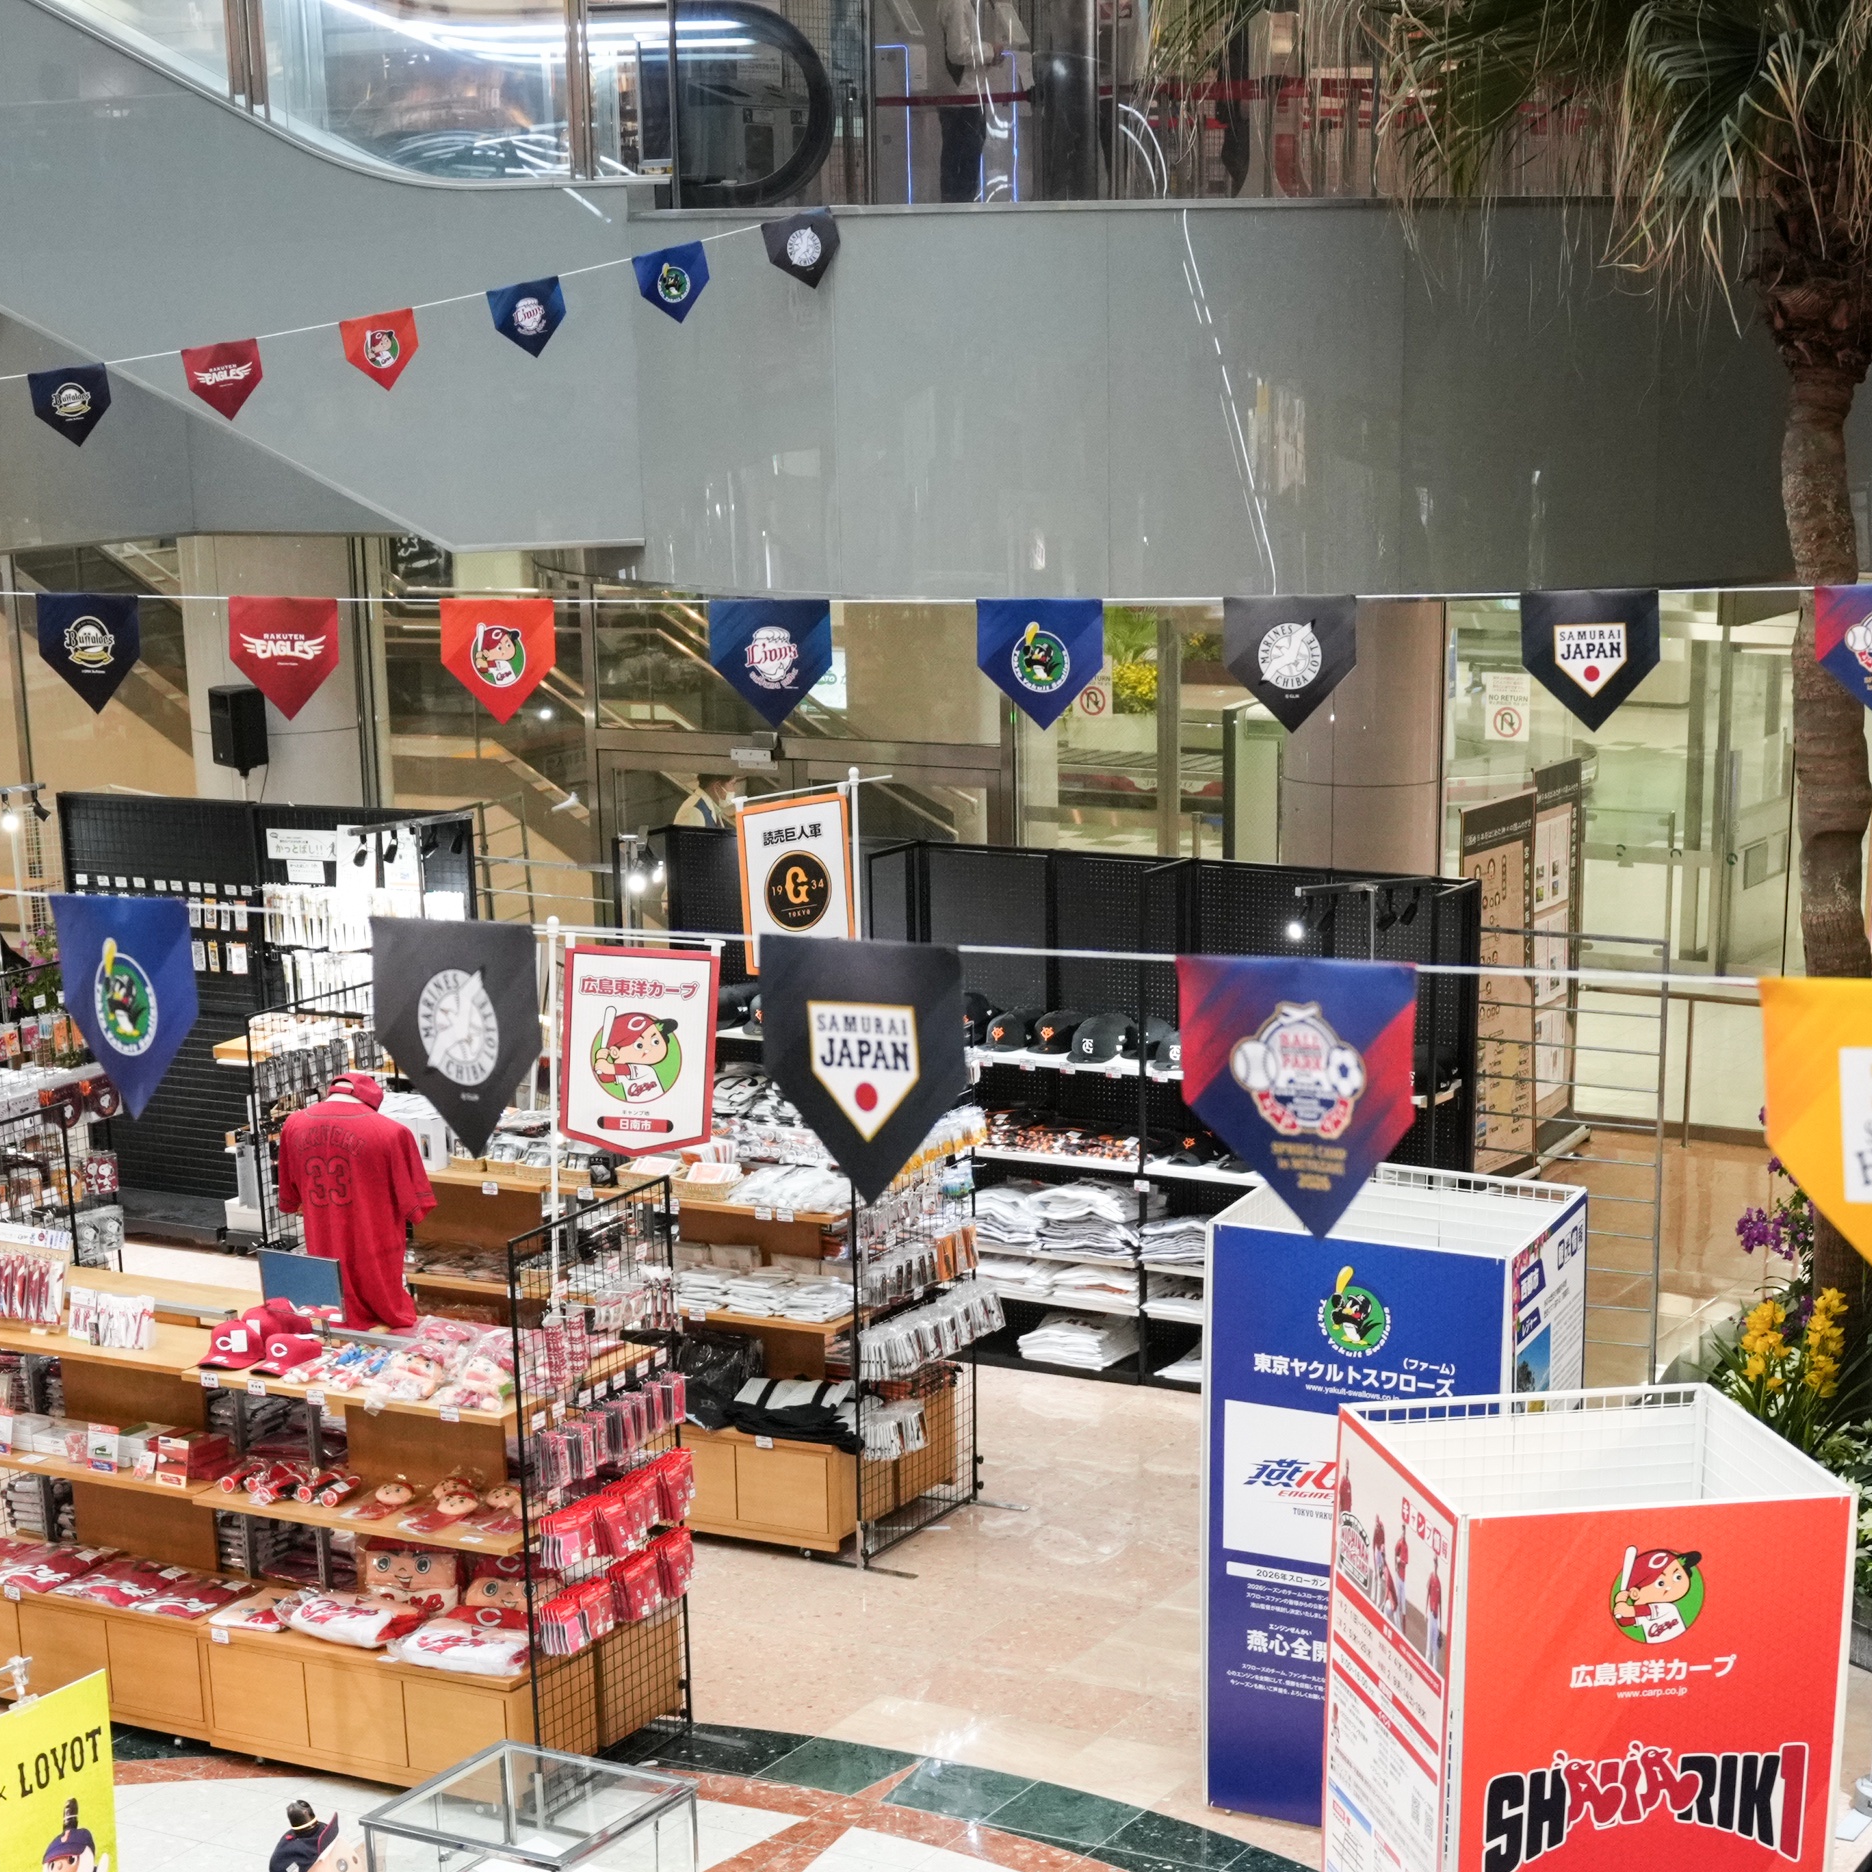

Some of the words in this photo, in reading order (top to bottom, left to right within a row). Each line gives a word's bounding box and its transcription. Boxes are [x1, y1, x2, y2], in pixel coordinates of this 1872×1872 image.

[263, 633, 306, 642] RAKUTEN
[1559, 627, 1625, 643] SAMURAI
[744, 641, 799, 671] Lions
[1559, 640, 1625, 661] JAPAN
[1275, 674, 1310, 689] CHIBA
[762, 823, 823, 848] 読売巨人軍
[771, 884, 784, 897] 19
[784, 866, 810, 905] G
[811, 878, 825, 891] 34
[788, 908, 811, 919] TOKYO
[579, 975, 700, 1000] 広島東洋カープ
[817, 1012, 910, 1037] SAMURAI
[819, 1036, 911, 1072] JAPAN
[444, 1062, 488, 1085] CHIBA
[619, 1118, 652, 1132] 日南市
[1327, 1336, 1364, 1360] Yakult
[1253, 1352, 1455, 1398] 東京ヤクルトスワローズ
[1277, 1490, 1333, 1501] ENGINE
[1292, 1507, 1313, 1518] TOKYO
[1255, 1567, 1327, 1587] 2026年スローガン
[1246, 1628, 1329, 1663] 燕心全開
[1569, 1653, 1737, 1690] 広島東洋カープ
[1616, 1685, 1688, 1700] www.carp.co.jp
[17, 1725, 103, 1800] LOVOT
